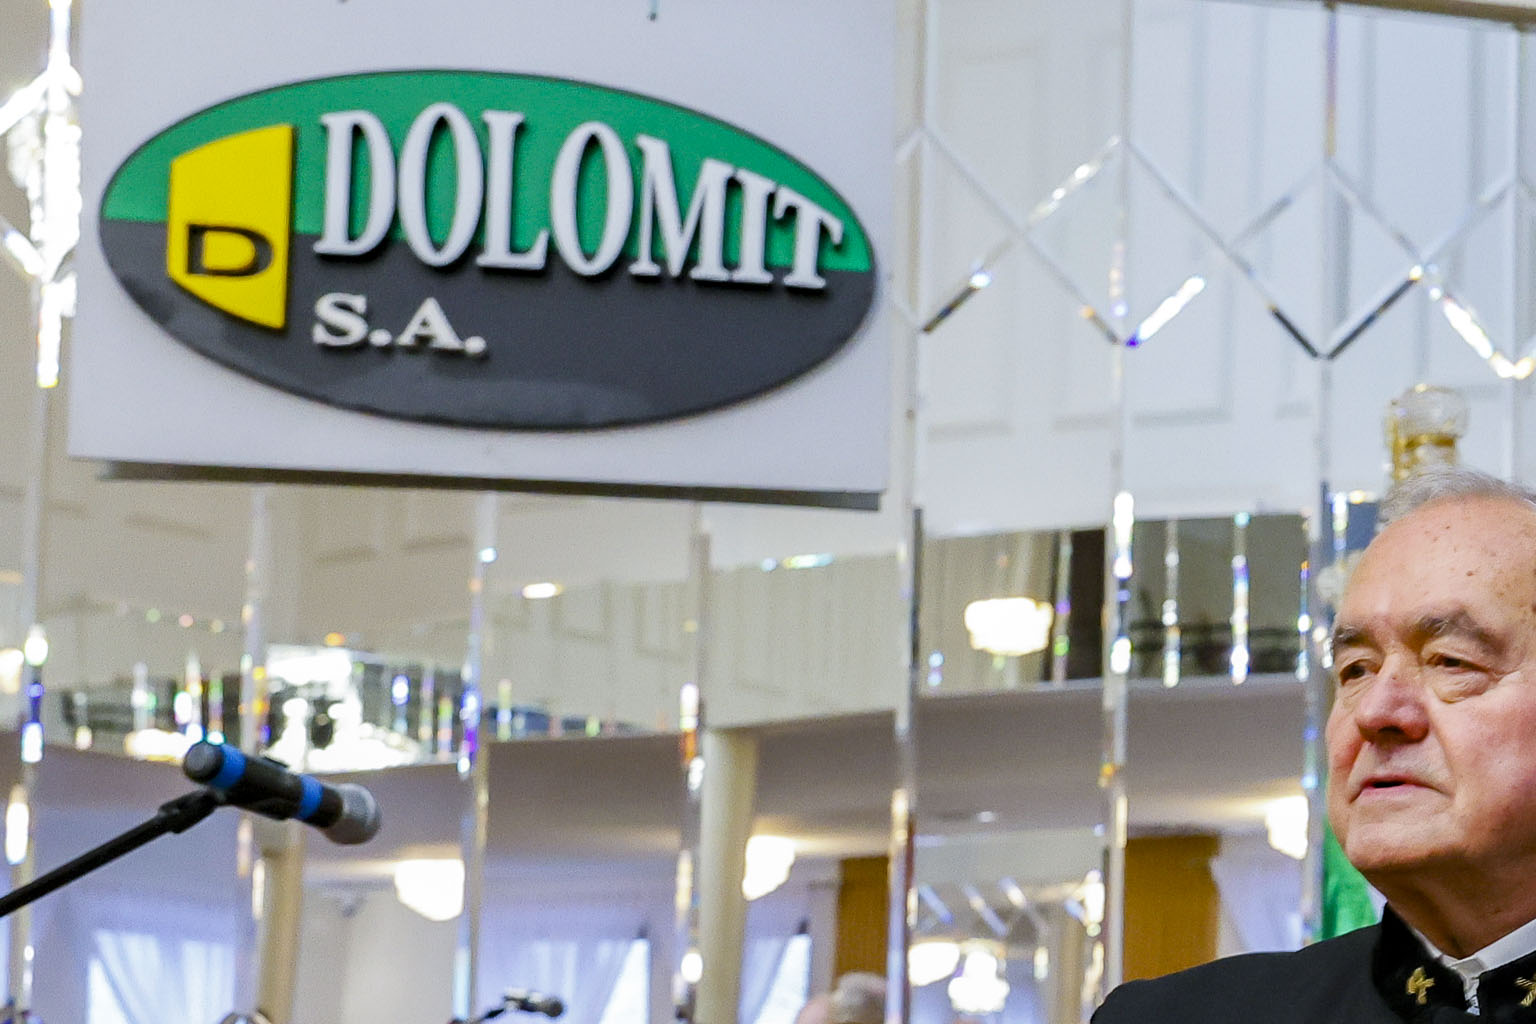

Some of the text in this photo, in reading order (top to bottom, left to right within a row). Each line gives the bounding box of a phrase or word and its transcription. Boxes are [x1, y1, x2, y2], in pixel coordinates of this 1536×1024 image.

[313, 101, 844, 291] DOLOMIT
[185, 223, 274, 277] D
[311, 292, 488, 356] S.A.
